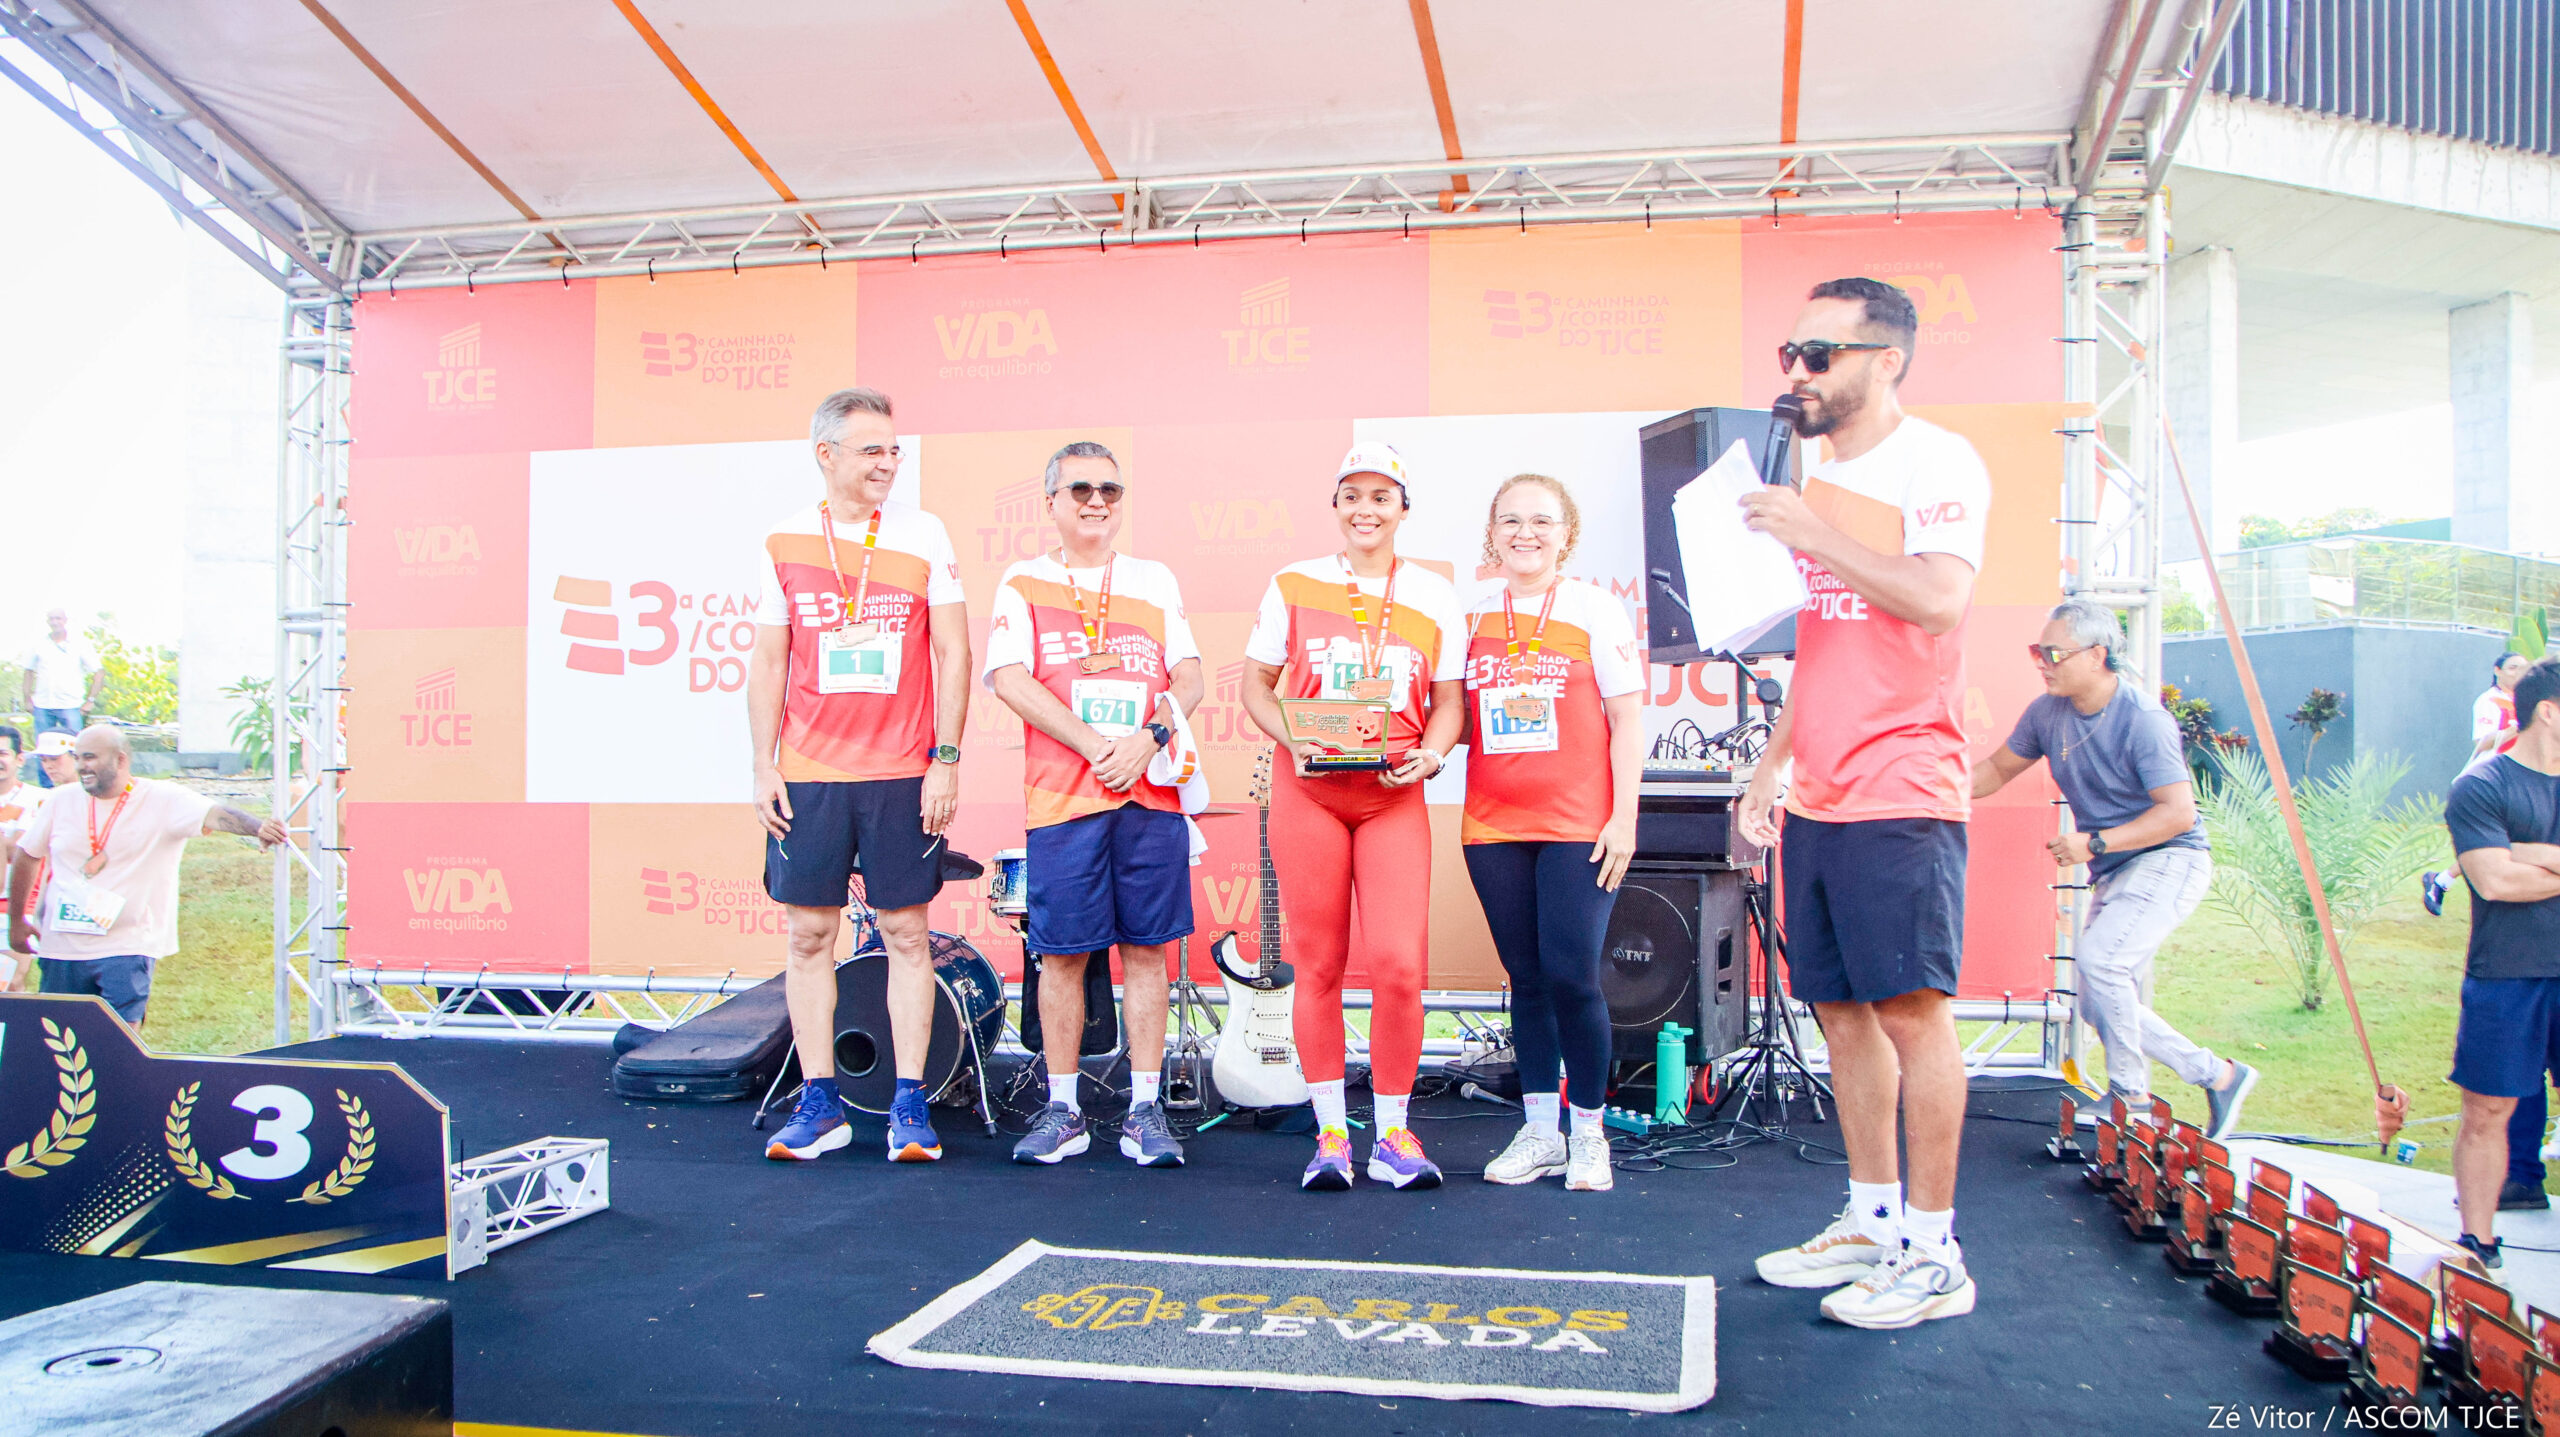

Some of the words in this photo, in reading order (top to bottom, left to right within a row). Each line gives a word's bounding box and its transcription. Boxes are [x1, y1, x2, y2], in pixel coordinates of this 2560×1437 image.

[1863, 261, 1944, 272] PROGRAMA
[1566, 295, 1670, 309] CAMINHADA
[708, 333, 796, 348] CAMINHADA
[934, 309, 1058, 360] VIDA
[1221, 327, 1310, 365] TJCE
[1559, 329, 1592, 347] DO
[1595, 328, 1663, 355] TJCE
[702, 366, 729, 384] DO
[732, 364, 789, 391] TJCE
[939, 365, 963, 378] em
[967, 358, 1053, 382] equilíbrio
[422, 368, 497, 404] TJCE
[1189, 499, 1296, 540] VIDA
[393, 524, 482, 563] VIDA
[1819, 591, 1869, 620] TJCE
[629, 580, 693, 665] 3ª
[689, 657, 747, 692] DO
[850, 651, 861, 673] 1
[1120, 653, 1159, 678] TJCE
[1089, 699, 1128, 723] 671
[1197, 706, 1274, 742] TJC
[399, 713, 473, 747] TJCE
[425, 856, 488, 866] PROGRAMA
[402, 867, 513, 914] VIDA
[408, 917, 430, 930] em
[432, 914, 508, 935] equilíbrio
[704, 908, 731, 925] DO
[735, 909, 789, 935] TJCE
[1624, 949, 1653, 962] TNT
[220, 1084, 314, 1181] 3
[1196, 1293, 1628, 1332] CARLOS
[1186, 1312, 1608, 1355] LEVADA
